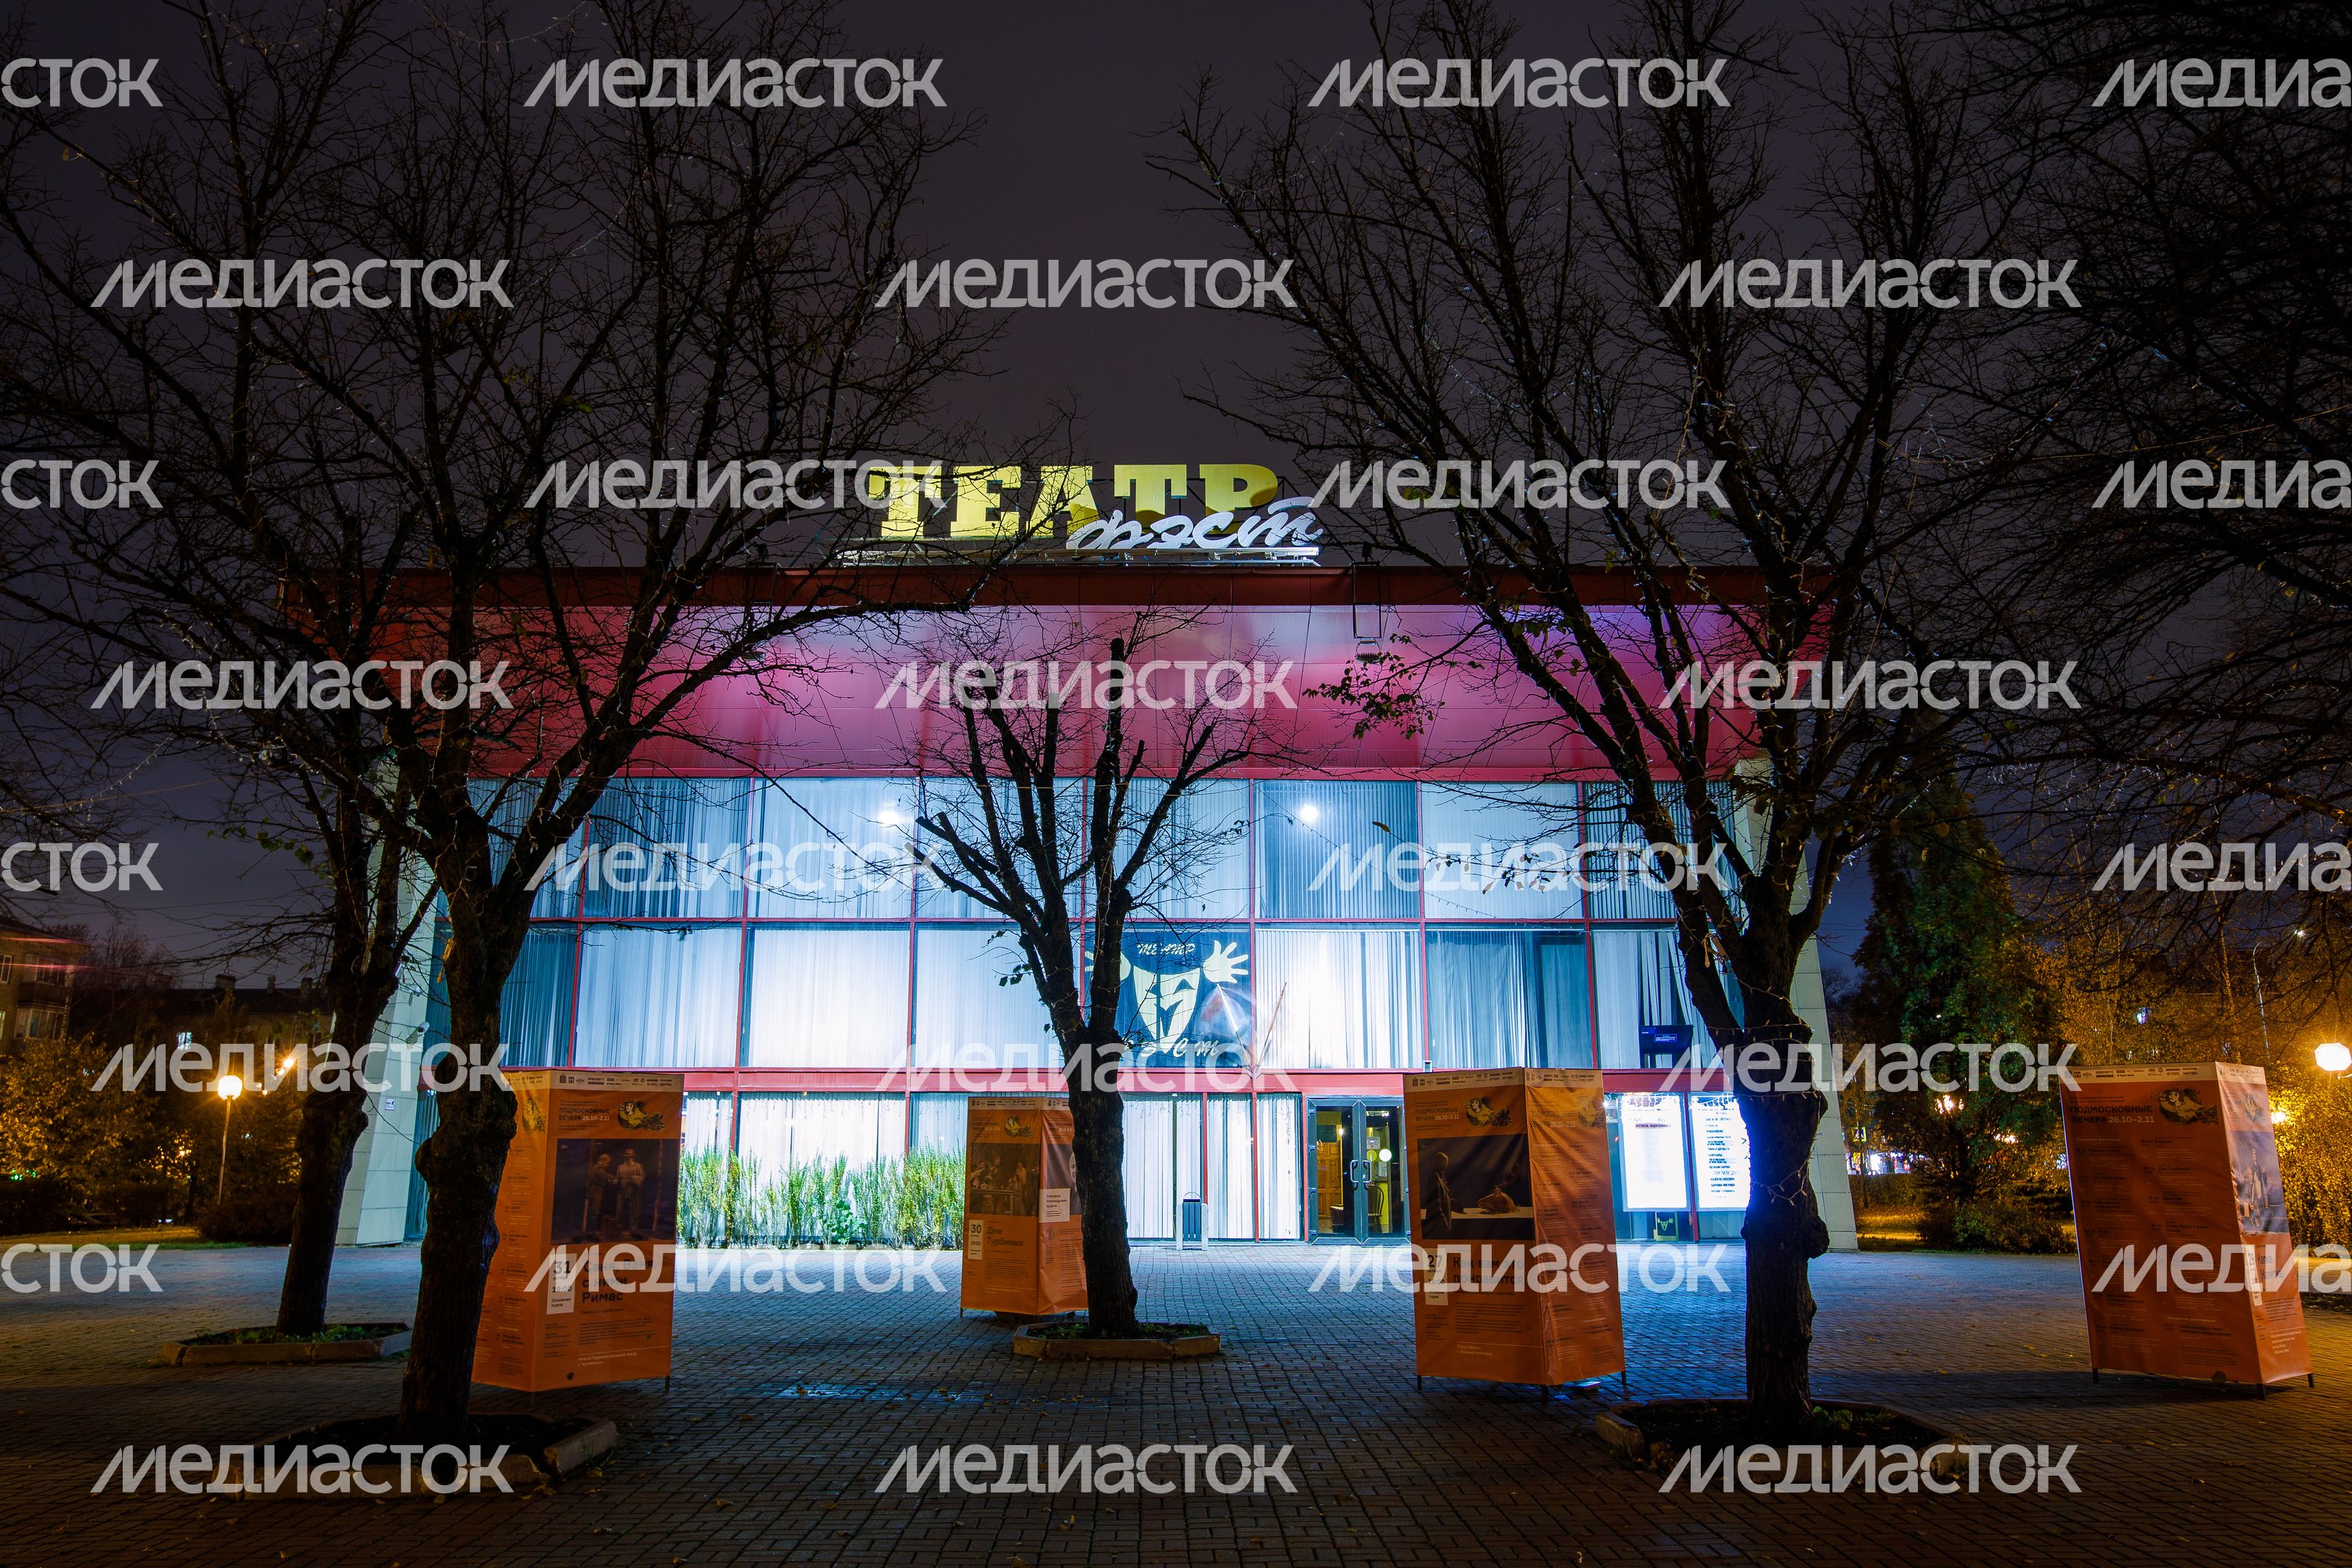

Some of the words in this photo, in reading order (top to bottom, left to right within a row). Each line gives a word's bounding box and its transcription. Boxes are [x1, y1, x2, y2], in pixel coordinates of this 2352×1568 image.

[869, 464, 1278, 538] ТЕАТР
[971, 1225, 981, 1233] 30
[1427, 1254, 1443, 1267] 27
[1453, 1257, 1474, 1268] Как
[1478, 1260, 1499, 1269] вам
[1503, 1260, 1524, 1269] это
[2248, 1252, 2255, 1266] 29
[554, 1260, 571, 1274] 31
[1453, 1275, 1524, 1286] понравится
[582, 1292, 624, 1304] Римас
